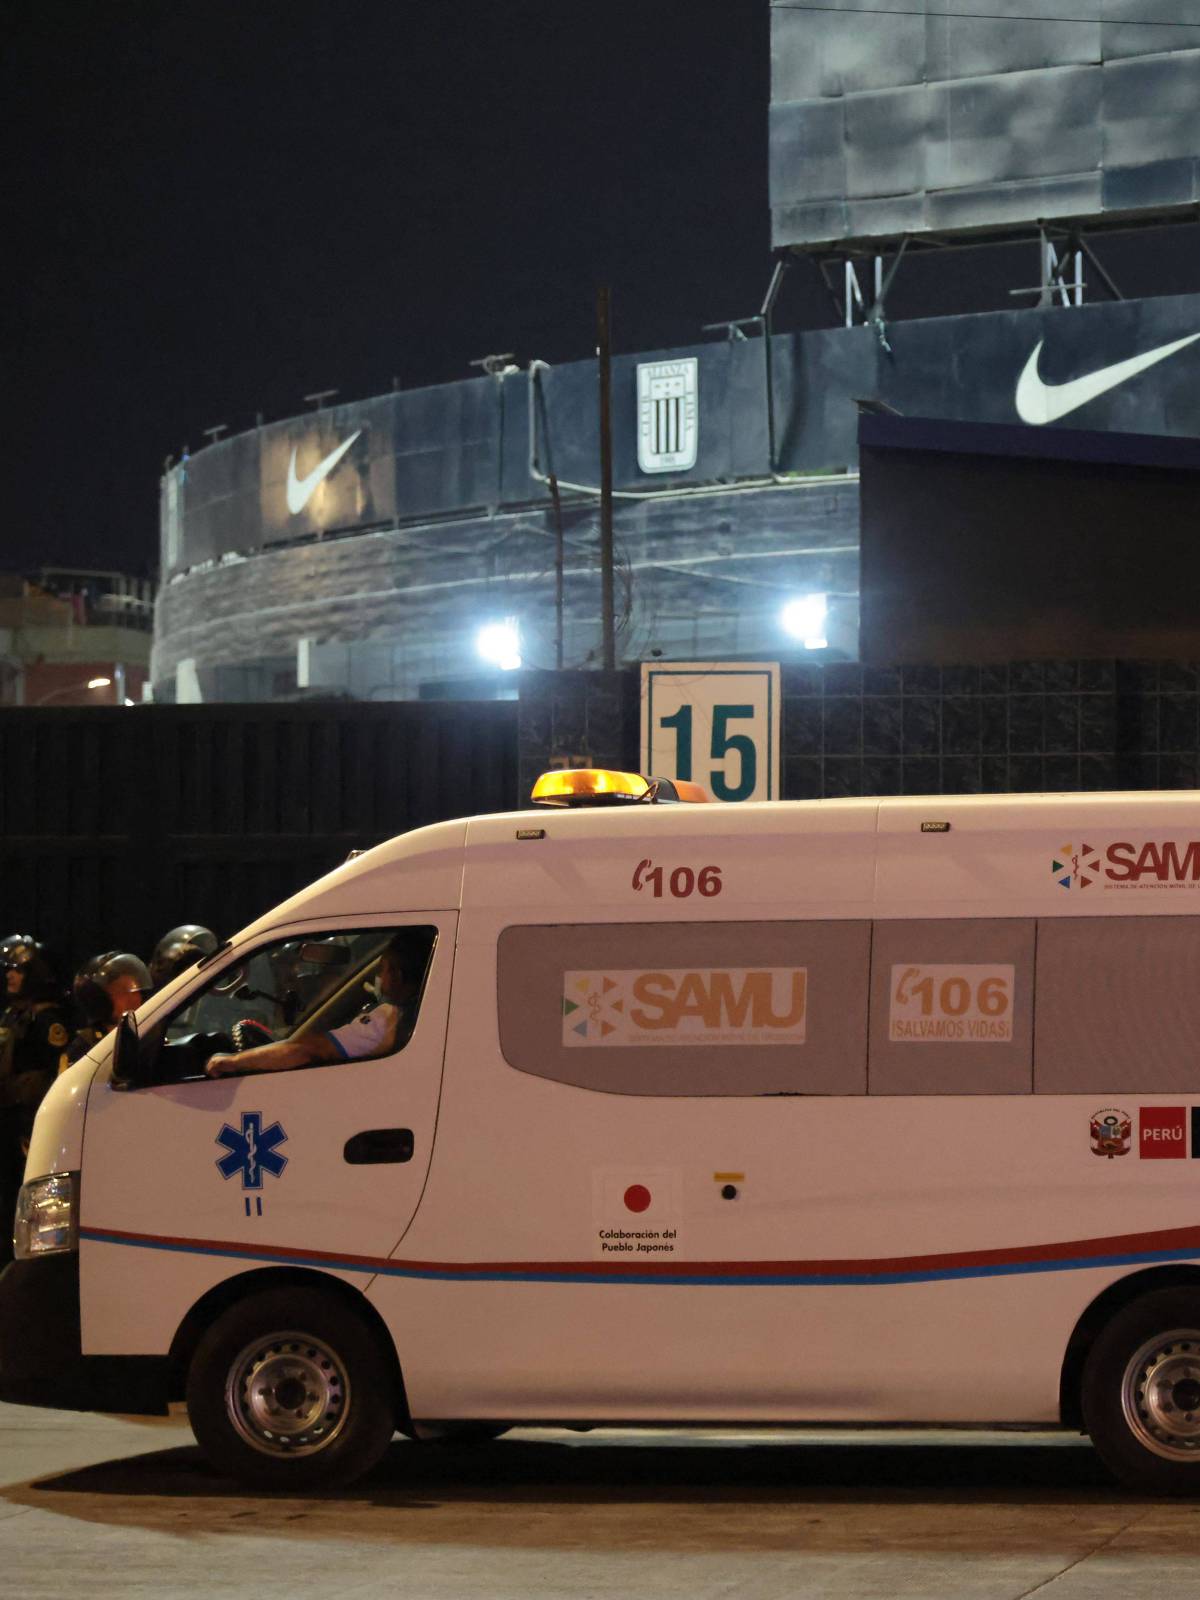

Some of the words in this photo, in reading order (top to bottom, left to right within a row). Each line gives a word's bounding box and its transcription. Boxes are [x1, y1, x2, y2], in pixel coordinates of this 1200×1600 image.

[660, 704, 757, 803] 15
[645, 866, 722, 898] 106
[630, 971, 806, 1030] SAMU
[911, 976, 1009, 1017] 106
[1142, 1125, 1183, 1141] PERÚ
[599, 1229, 660, 1239] Colaboración
[662, 1229, 677, 1239] del
[602, 1242, 634, 1252] Pueblo
[636, 1242, 674, 1254] Japonés
